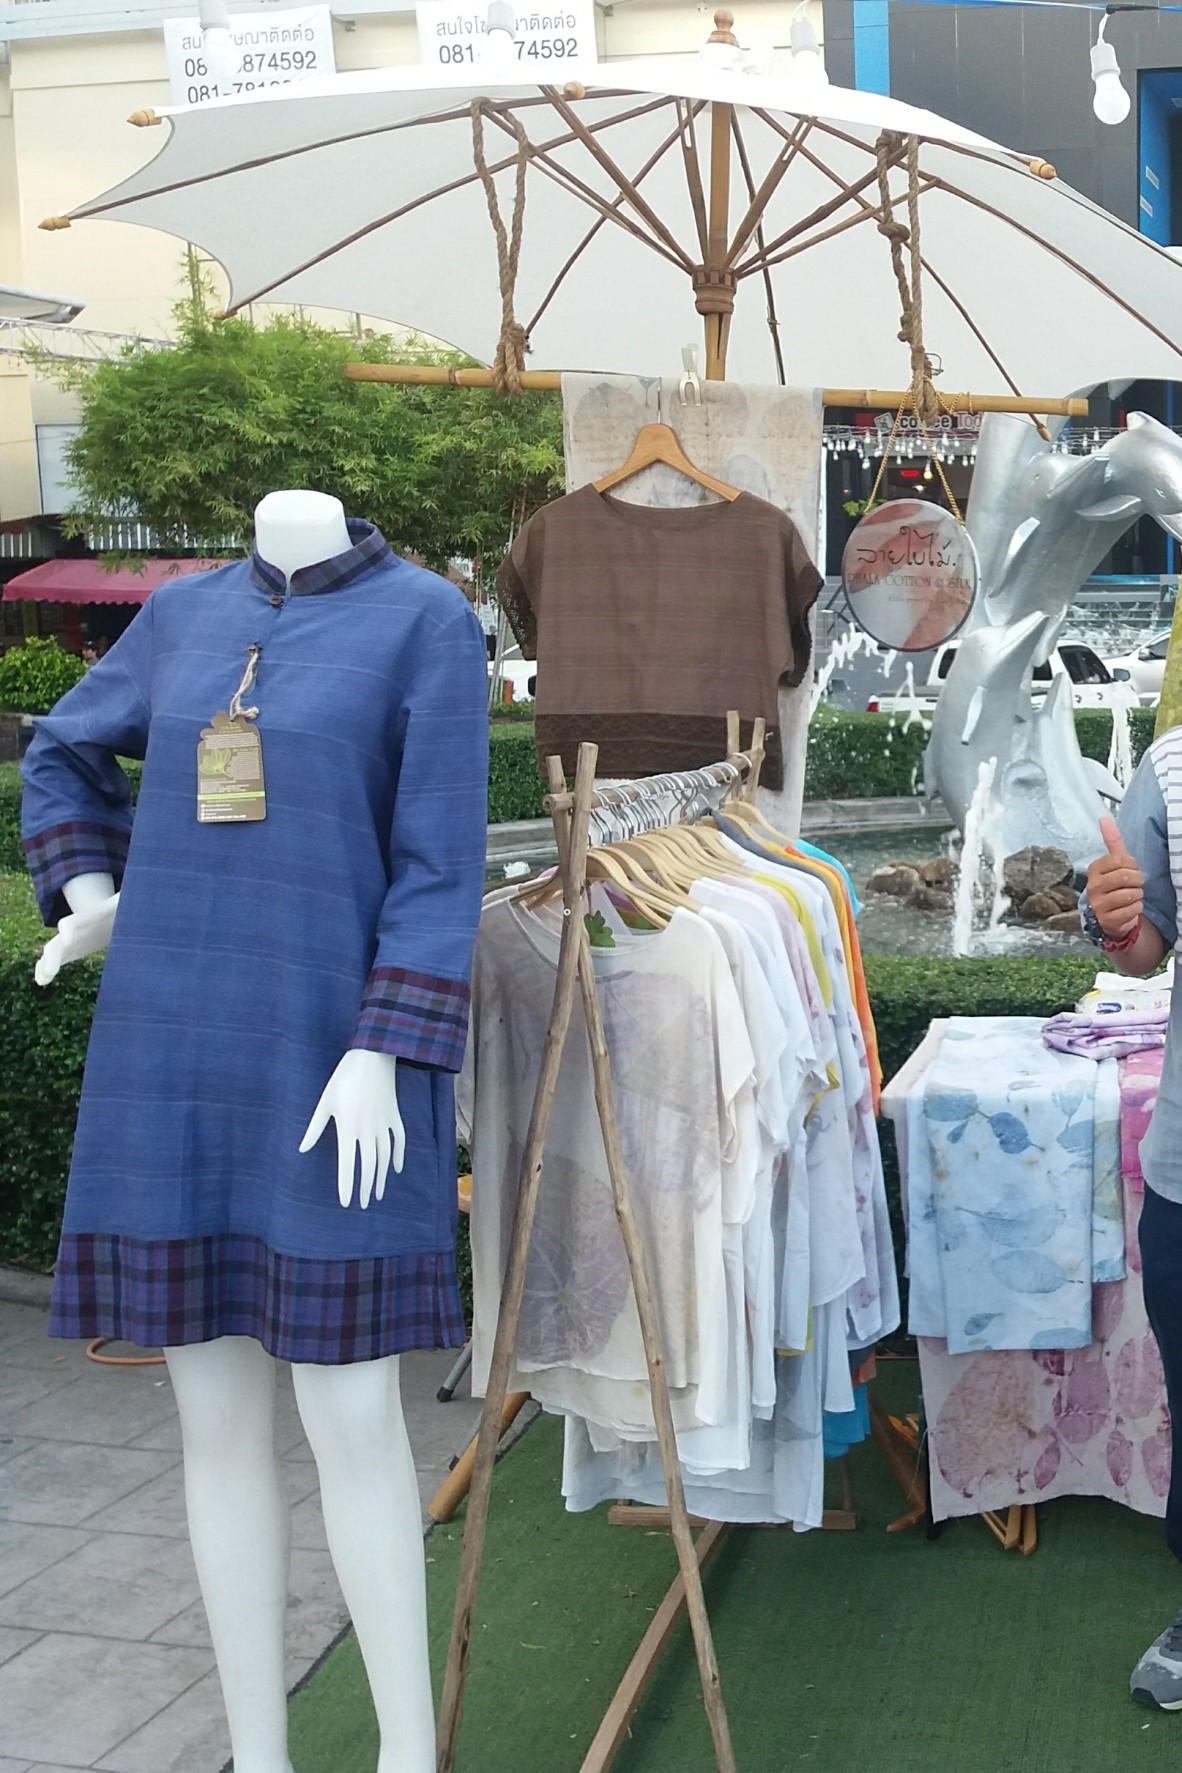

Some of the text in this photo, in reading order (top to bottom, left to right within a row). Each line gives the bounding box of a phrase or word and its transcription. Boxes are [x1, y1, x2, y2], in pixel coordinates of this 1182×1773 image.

[184, 50, 318, 78] 08874592
[439, 37, 579, 64] 08174592
[885, 575, 931, 587] COTTON
[948, 577, 972, 589] SILK
